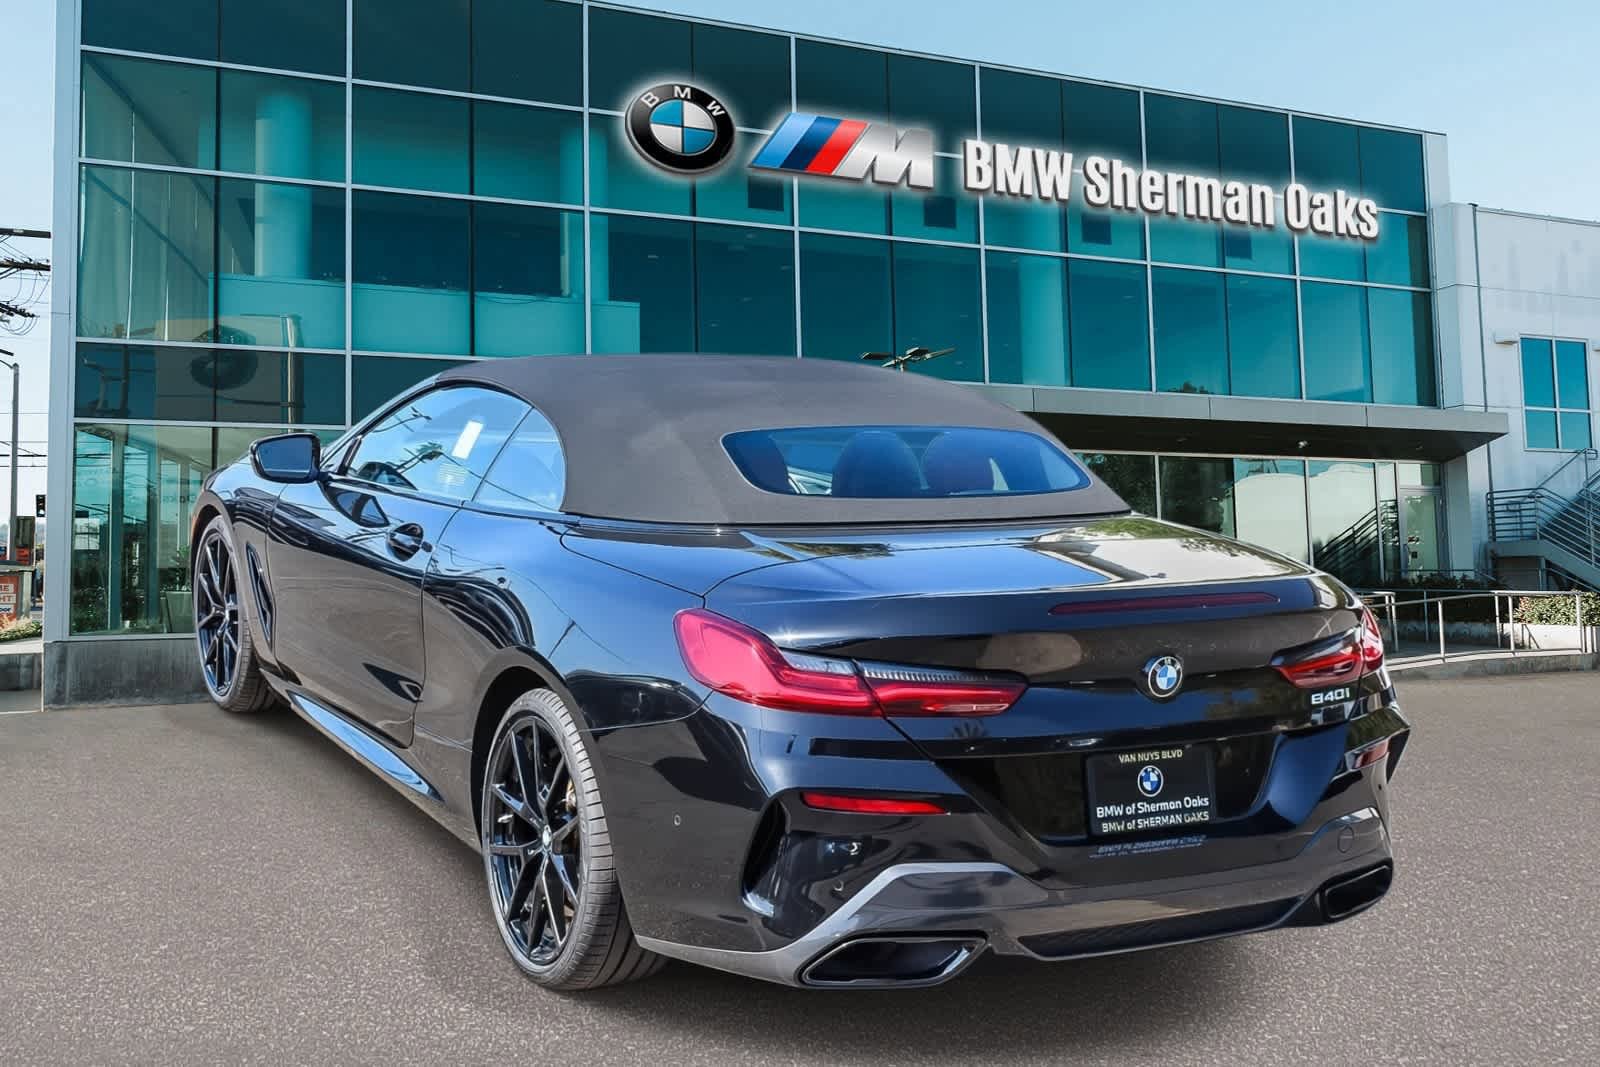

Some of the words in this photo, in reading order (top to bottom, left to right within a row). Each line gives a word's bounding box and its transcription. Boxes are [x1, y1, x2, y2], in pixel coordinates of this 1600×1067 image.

[641, 85, 725, 117] BMW
[964, 139, 1074, 201] BMW
[1083, 156, 1275, 227] Sherman
[1284, 183, 1379, 240] Oaks
[1118, 753, 1136, 764] VAN
[1137, 751, 1160, 762] NUYS
[1161, 749, 1183, 759] BLVD
[1096, 804, 1124, 818] BMW
[1125, 804, 1136, 816] of
[1137, 799, 1182, 814] Sherman
[1183, 795, 1209, 809] Oaks
[1102, 820, 1125, 833] BMW
[1126, 819, 1136, 830] of
[1137, 814, 1183, 829] SHERMAN
[1183, 810, 1210, 823] OAKS
